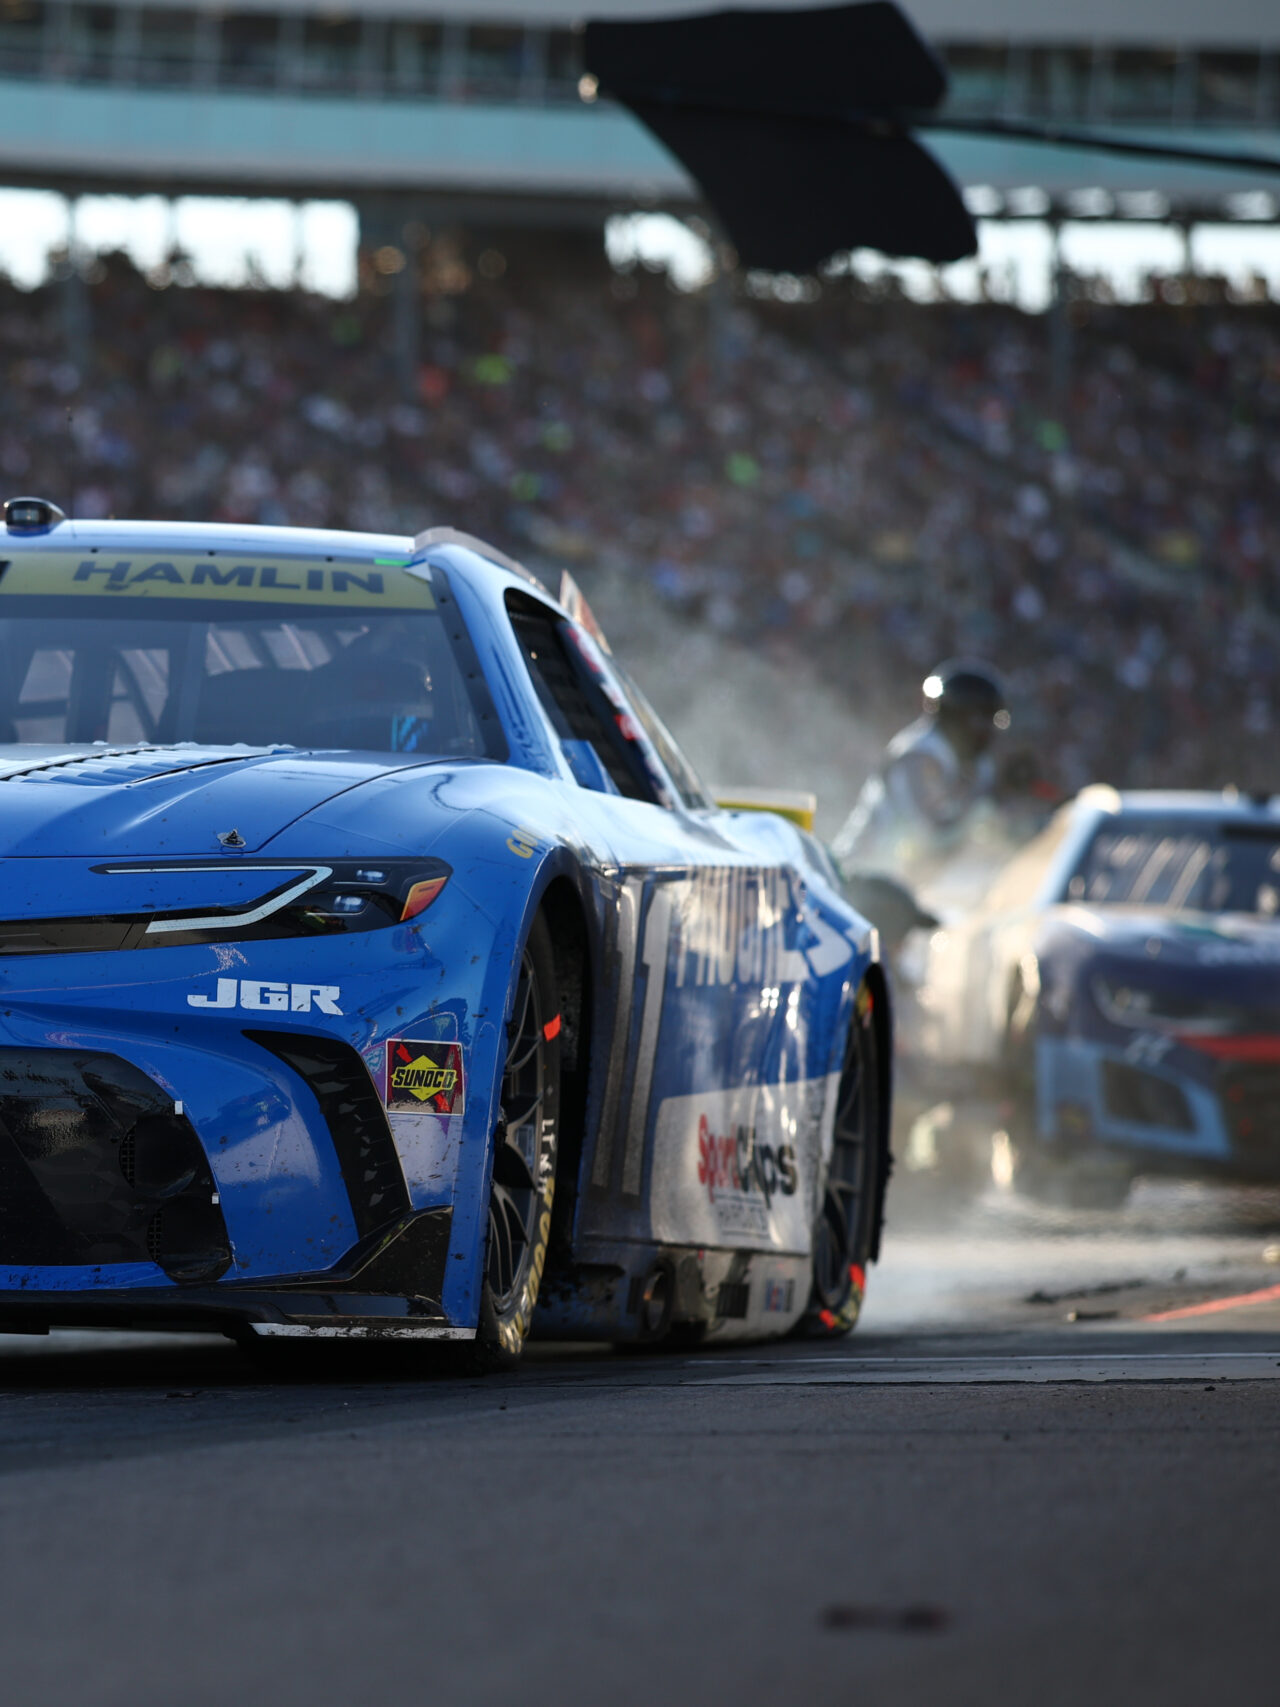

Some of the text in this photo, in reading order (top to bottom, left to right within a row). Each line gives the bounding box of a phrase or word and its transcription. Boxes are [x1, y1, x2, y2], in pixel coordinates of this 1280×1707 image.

[73, 560, 385, 595] HAMLIN
[187, 977, 344, 1016] JGR
[393, 1068, 455, 1089] SUNOCO
